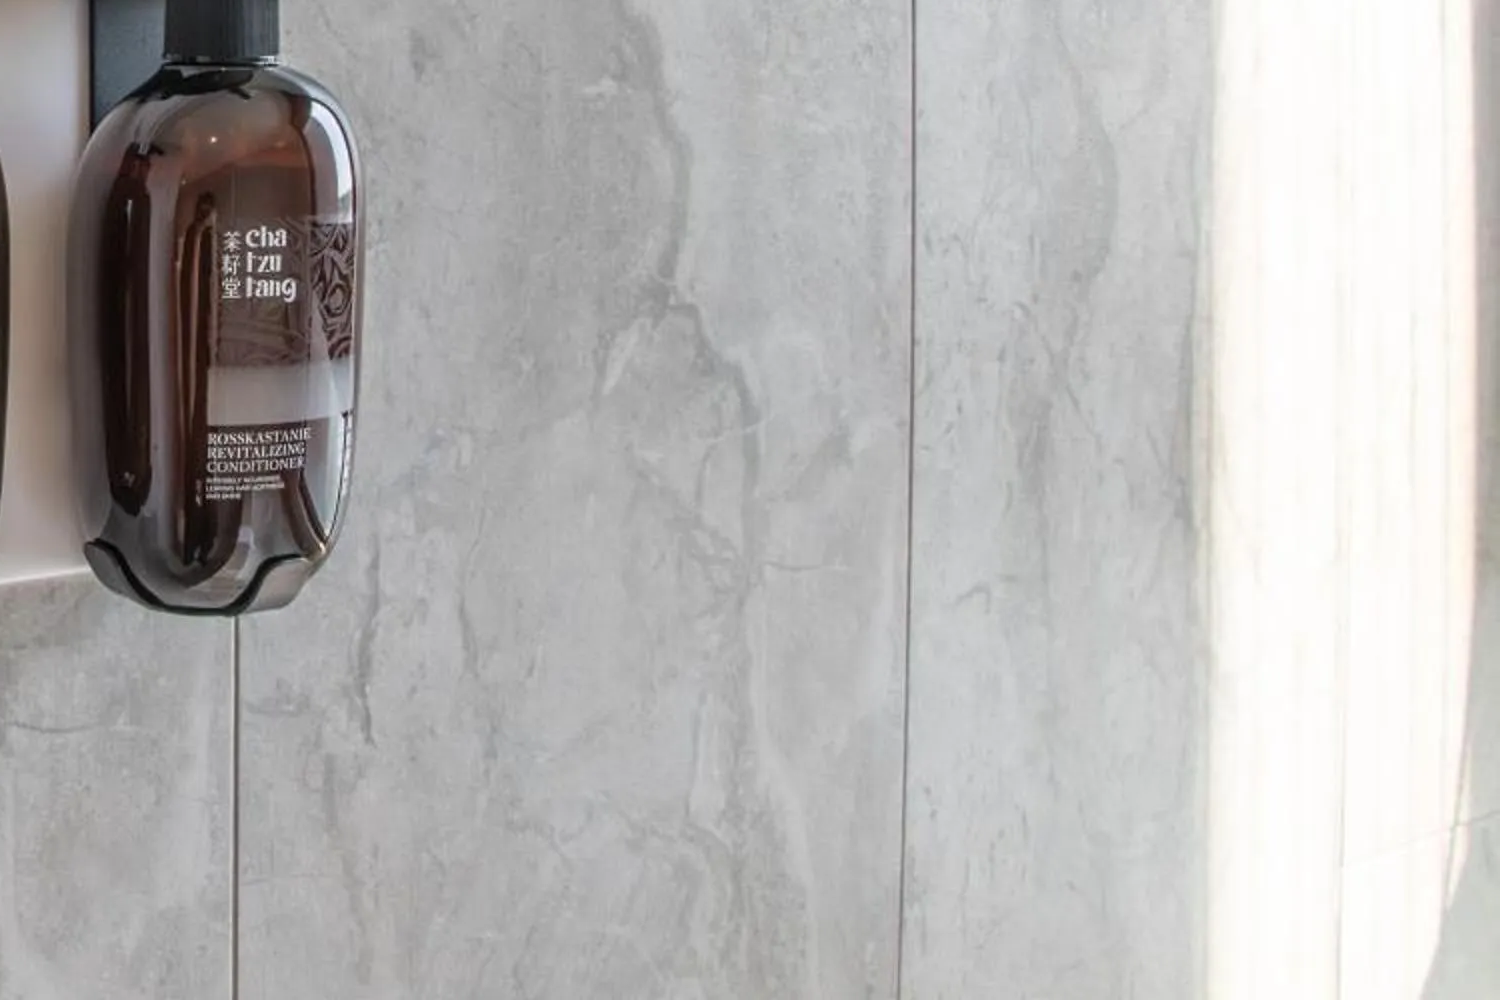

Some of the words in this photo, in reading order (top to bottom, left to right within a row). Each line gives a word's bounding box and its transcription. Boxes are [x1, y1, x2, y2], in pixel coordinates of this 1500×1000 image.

[245, 226, 287, 249] cha
[207, 427, 312, 445] ROSSKASTANIE
[207, 442, 305, 459] REVITALIZING
[206, 456, 305, 473] CONDITIONER
